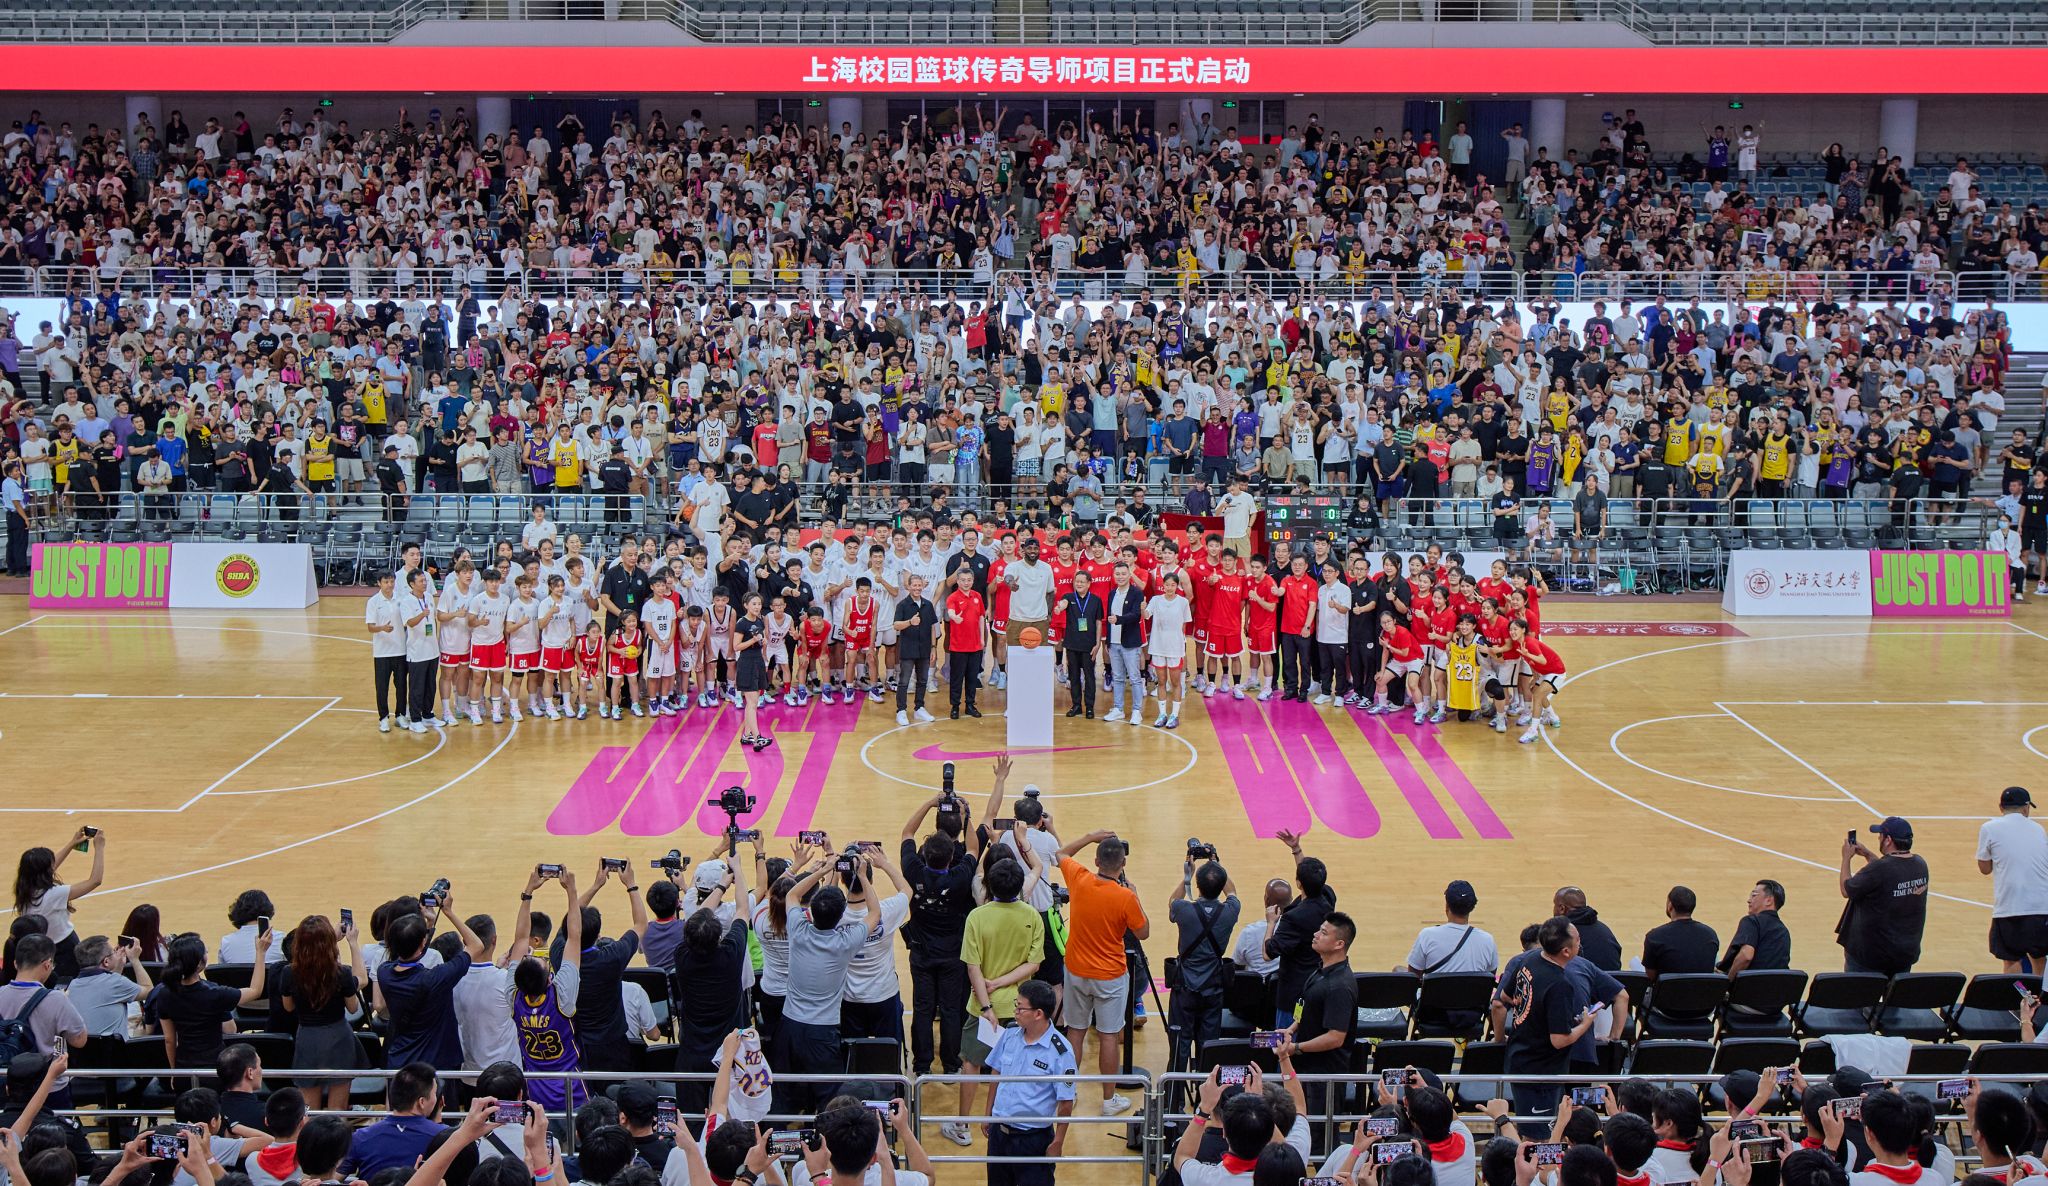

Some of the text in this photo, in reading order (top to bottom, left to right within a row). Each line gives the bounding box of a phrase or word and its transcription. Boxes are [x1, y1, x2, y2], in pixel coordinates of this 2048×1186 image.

[802, 56, 1250, 84] 上海校园篮球传奇导师项目正式启动
[979, 259, 988, 267] 23
[77, 340, 83, 348] 6
[1140, 360, 1149, 368] 23
[1050, 397, 1055, 405] 6
[1526, 392, 1535, 401] 23
[372, 398, 379, 406] 6
[1624, 420, 1633, 429] 23
[709, 438, 719, 447] 23
[1297, 435, 1307, 444] 23
[1671, 436, 1681, 445] 23
[562, 457, 572, 466] 23
[1767, 452, 1778, 462] 23
[1534, 458, 1545, 469] 23
[1280, 508, 1287, 519] 0
[1328, 509, 1335, 520] 0
[1273, 531, 1279, 540] 0
[1284, 531, 1291, 540] 0
[34, 547, 169, 597] JUST DO IT
[227, 572, 250, 580] SHBA
[1780, 571, 1861, 589] 上海交通大学
[1875, 554, 2006, 605] JUST DO IT
[1455, 662, 1473, 681] 23
[546, 688, 866, 838] JUST
[1200, 688, 1514, 839] DO IT
[1897, 881, 1910, 889] ONCE
[1893, 888, 1906, 896] TIME
[520, 1015, 550, 1028] JAMES
[525, 1029, 564, 1061] 23
[738, 1069, 773, 1098] 23
